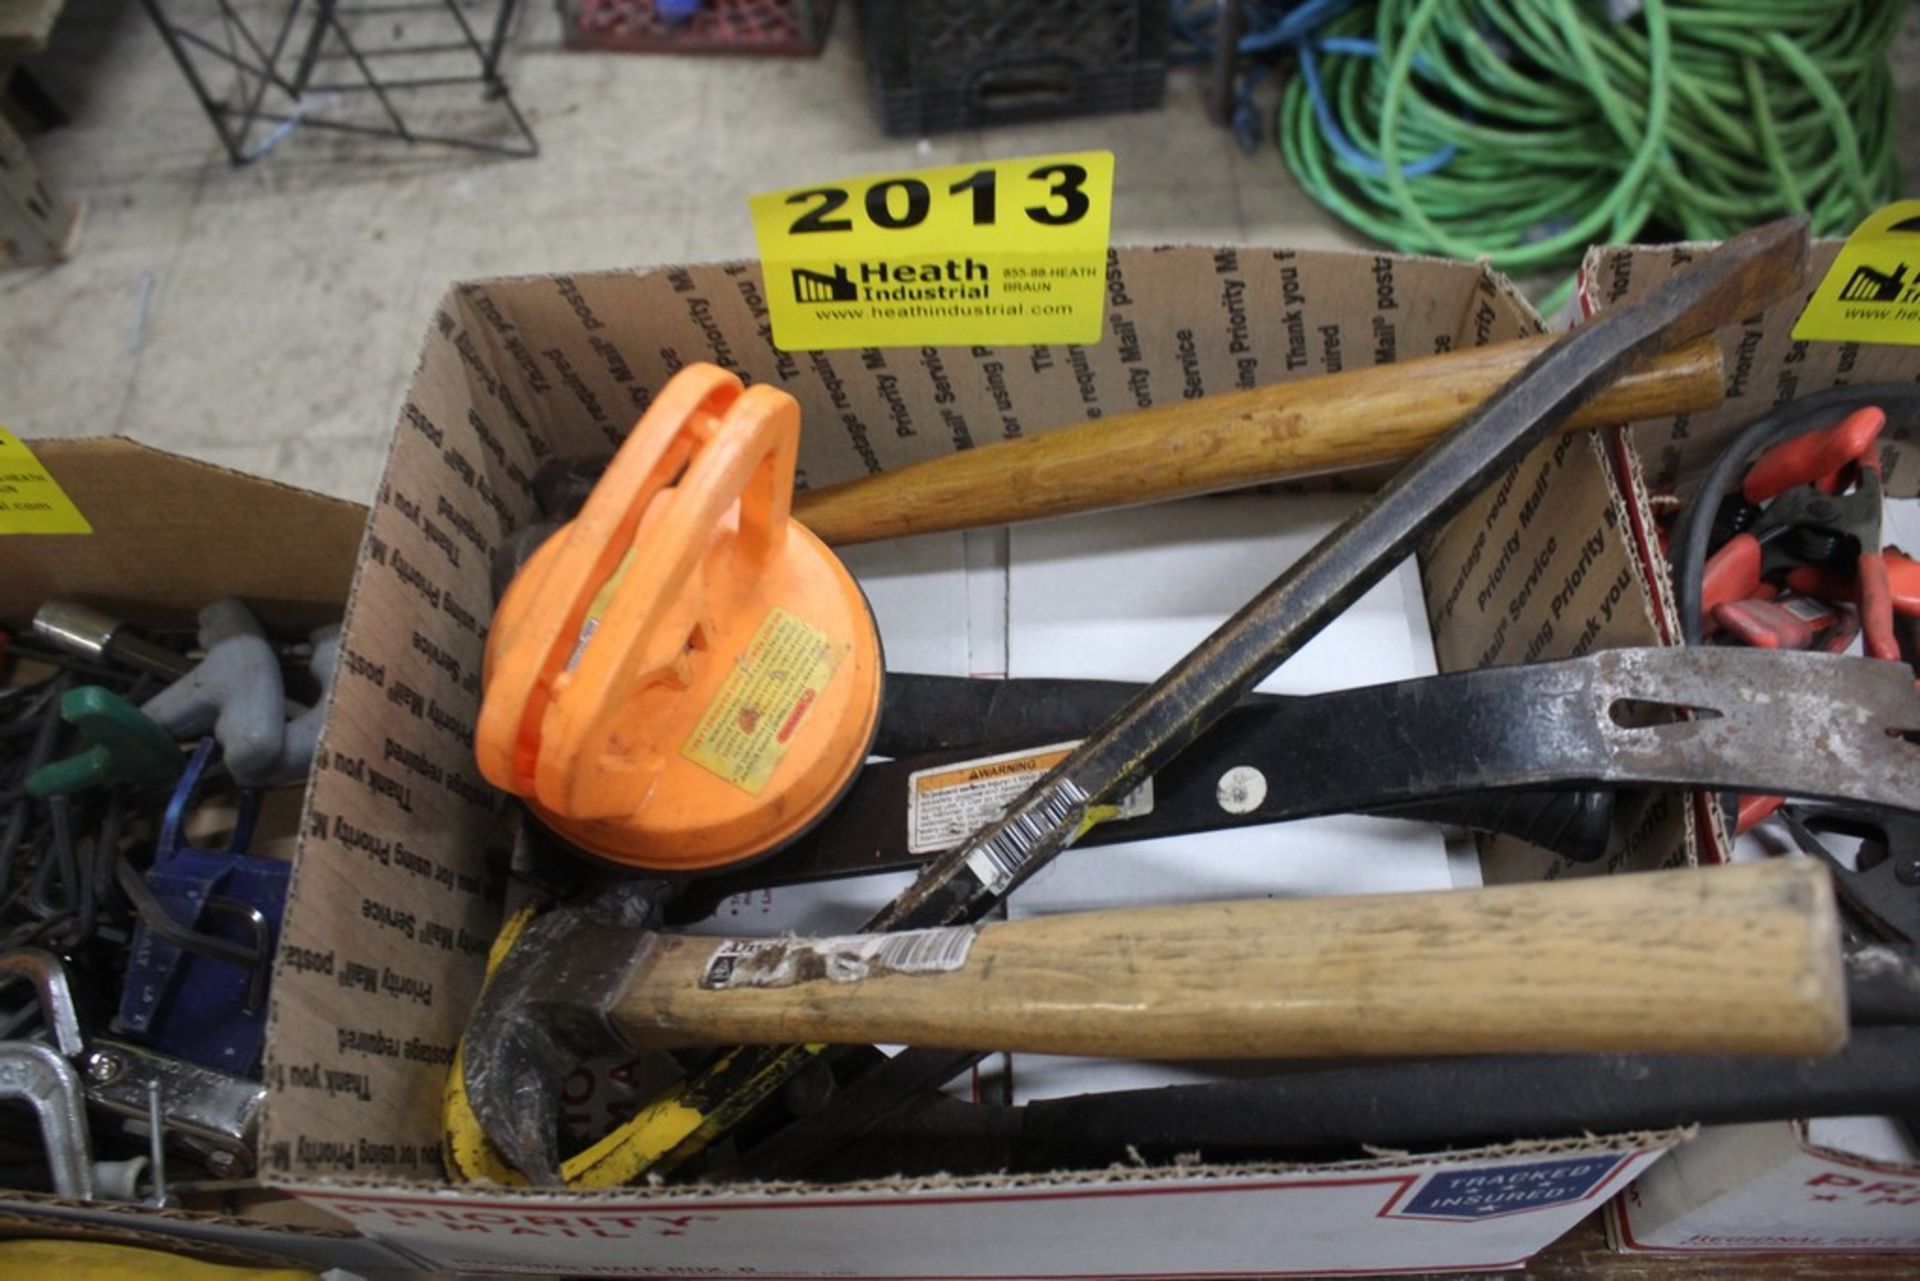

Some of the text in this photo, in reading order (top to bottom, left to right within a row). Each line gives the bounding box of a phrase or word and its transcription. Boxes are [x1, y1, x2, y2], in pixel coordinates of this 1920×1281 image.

[784, 163, 1091, 235] 2013
[859, 258, 990, 284] Heath
[861, 284, 990, 302] Industrial
[1002, 266, 1098, 279] 855-88-HEATH
[1002, 281, 1052, 294] BRAUN
[738, 279, 771, 322] you
[815, 302, 1074, 321] www.heathindustrial.com
[1218, 278, 1249, 360] Priority
[1281, 267, 1309, 372] Thank you
[686, 297, 740, 375] Priority
[1174, 329, 1205, 400] Service
[875, 373, 918, 439] Priority
[983, 361, 1013, 420] using
[389, 547, 441, 610] Priority
[1445, 531, 1487, 616] postage
[1477, 529, 1522, 612] Priority
[1508, 535, 1558, 623] Service
[1551, 527, 1605, 621] Priority
[1600, 566, 1632, 623] you
[334, 752, 413, 813] Thank you
[383, 736, 443, 784] required
[977, 758, 1037, 780] WARNING
[333, 815, 391, 867] Priority
[393, 841, 433, 878] using
[361, 898, 416, 940] Service
[381, 967, 434, 1006] Priority
[337, 1027, 401, 1058] required
[290, 1062, 321, 1090] you
[324, 1069, 372, 1101] Thank
[296, 1135, 355, 1171] Priority
[358, 1137, 398, 1170] using
